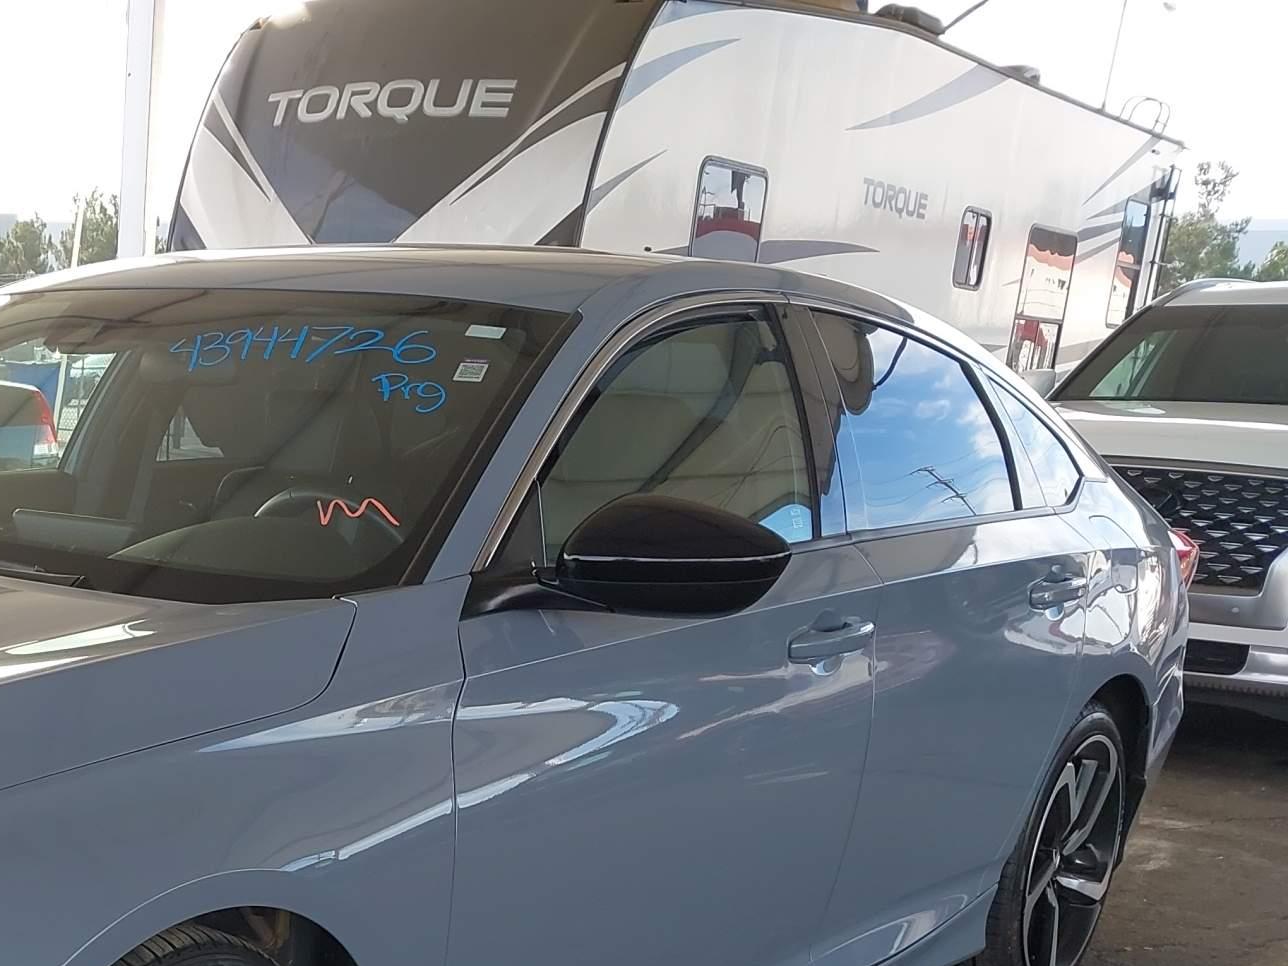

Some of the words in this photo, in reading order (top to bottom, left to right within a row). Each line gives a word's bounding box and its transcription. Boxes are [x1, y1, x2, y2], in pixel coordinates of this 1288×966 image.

[268, 79, 518, 126] TORQUE
[863, 177, 929, 220] TORQUE
[169, 325, 437, 373] 43944726
